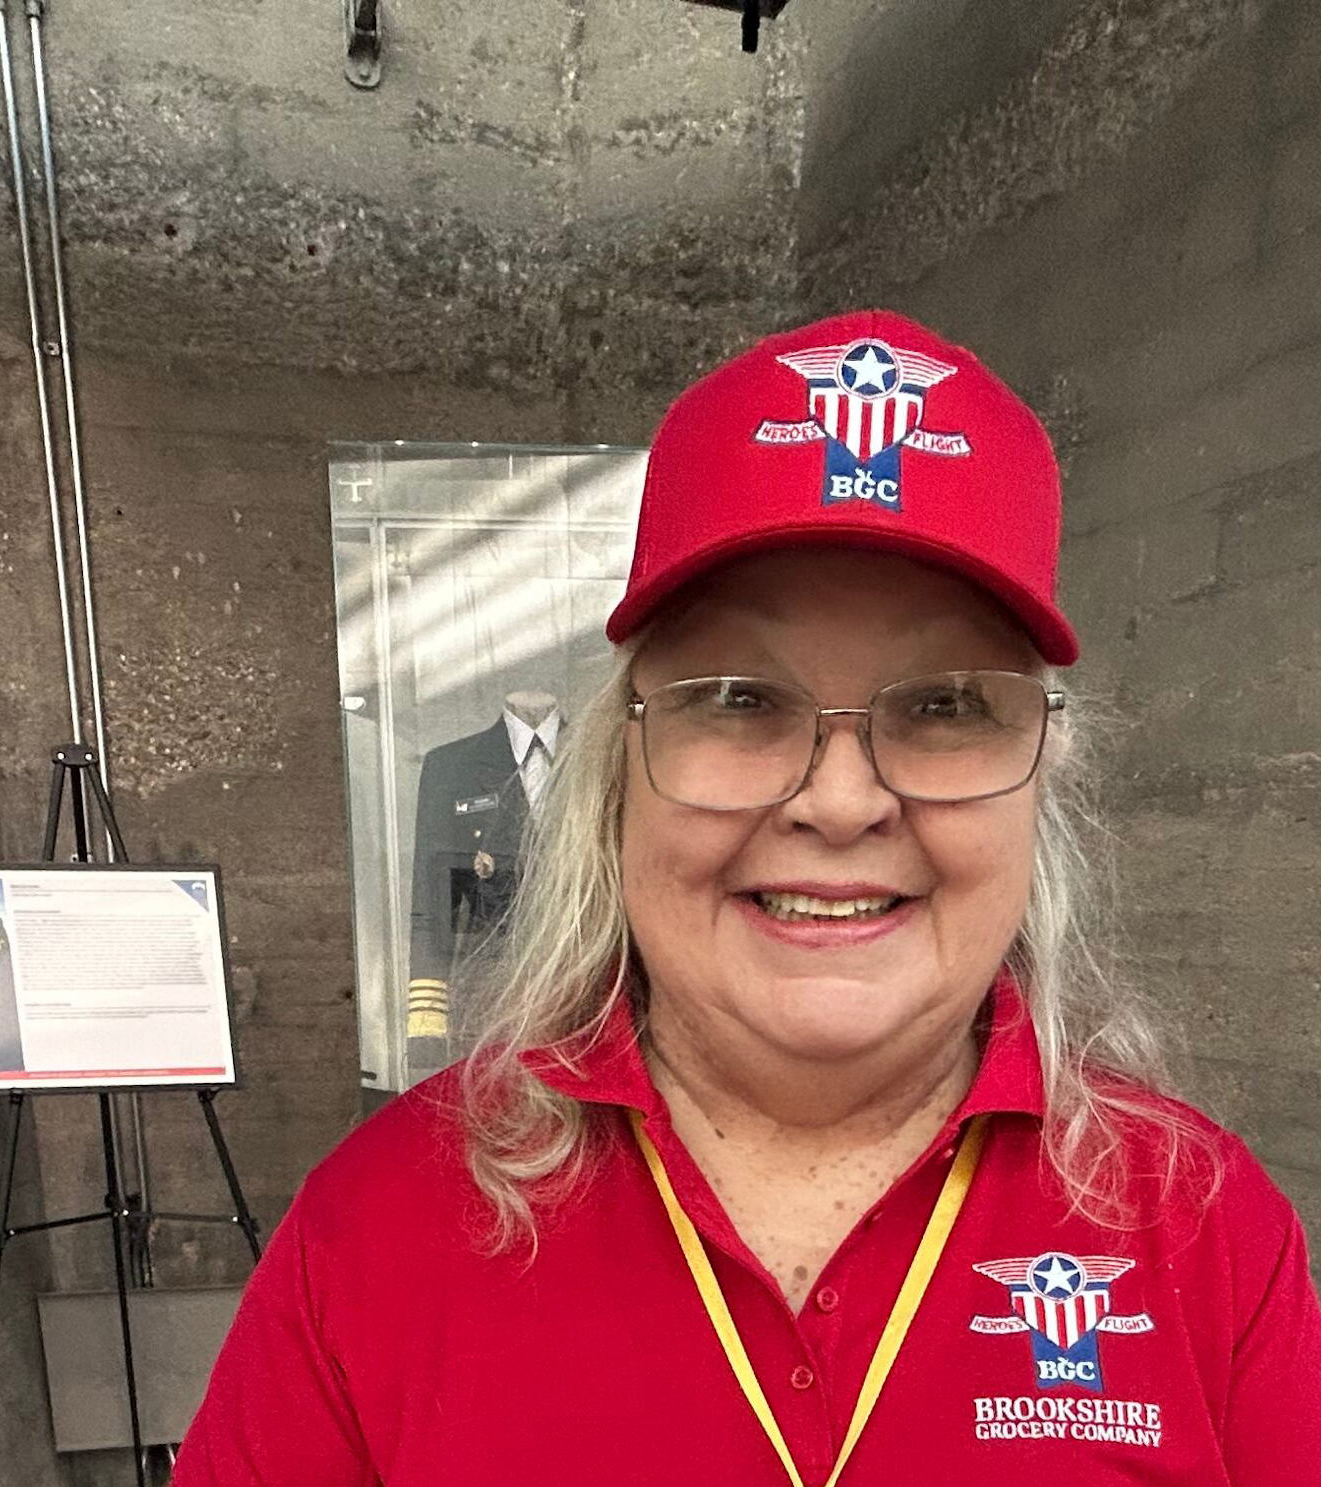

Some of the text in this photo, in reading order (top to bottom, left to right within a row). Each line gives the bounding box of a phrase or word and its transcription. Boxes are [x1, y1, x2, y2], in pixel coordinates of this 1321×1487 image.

[761, 423, 963, 451] HEROES FLIGHT
[829, 474, 899, 502] BGC
[974, 1317, 1148, 1331] HEROES FLIGHT
[1036, 1359, 1096, 1381] BGC
[973, 1397, 1162, 1430] BROOKSHIRE
[975, 1421, 1163, 1448] GROCERY COMPANY
